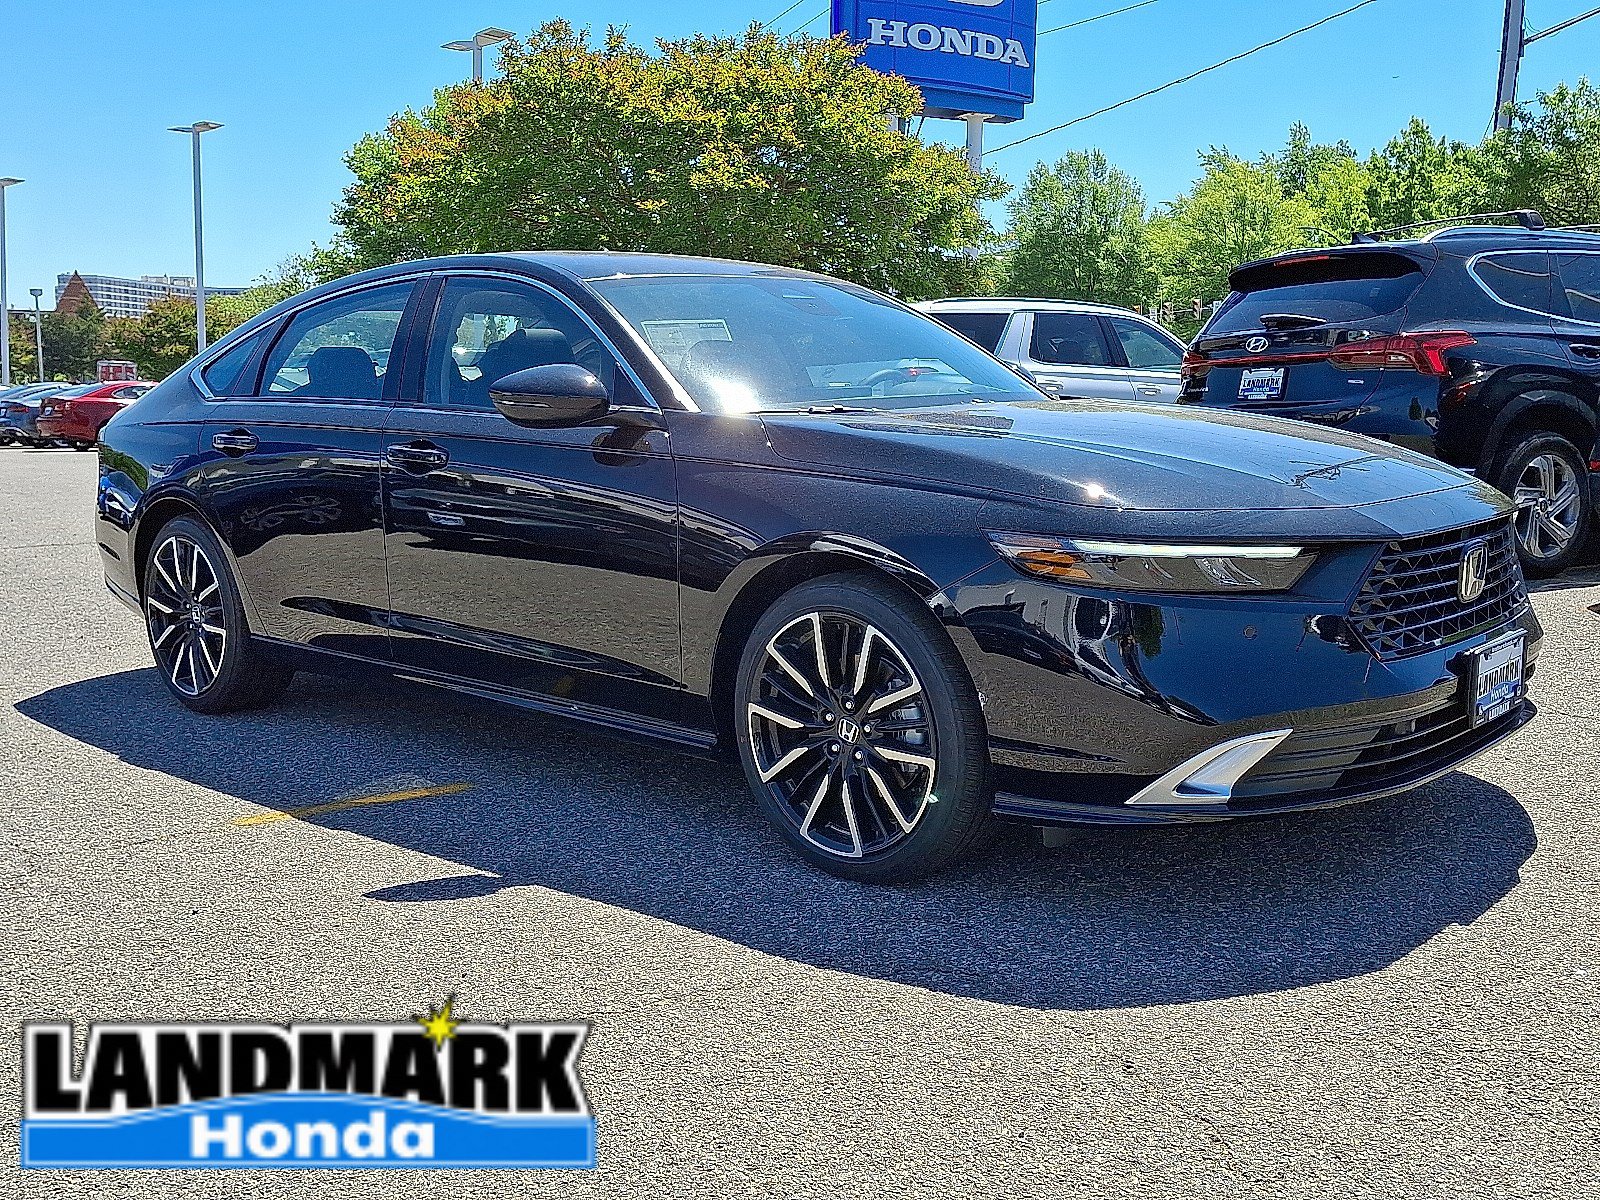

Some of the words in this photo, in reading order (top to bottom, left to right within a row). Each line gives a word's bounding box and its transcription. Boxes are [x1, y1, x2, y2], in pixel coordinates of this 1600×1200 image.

[867, 18, 1030, 68] HONDA
[1478, 659, 1520, 697] LANDMARK
[1490, 683, 1509, 702] Honda
